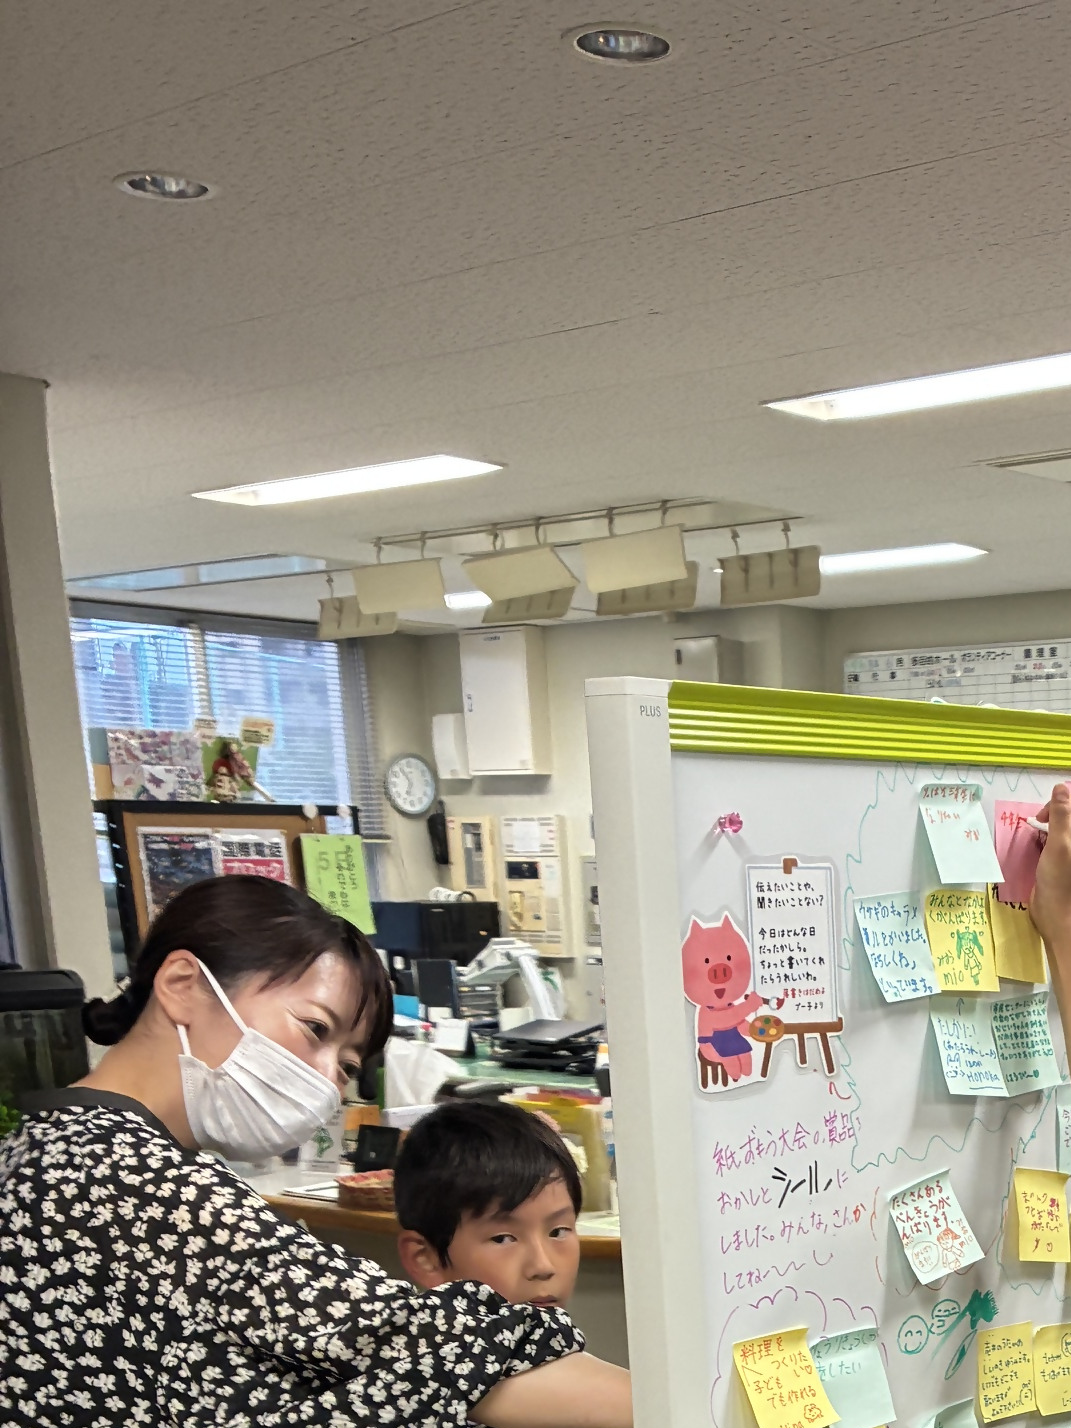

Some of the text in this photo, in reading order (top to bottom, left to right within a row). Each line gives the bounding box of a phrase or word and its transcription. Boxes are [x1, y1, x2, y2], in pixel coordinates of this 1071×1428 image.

[640, 705, 661, 717] PLUS
[756, 881, 815, 893] 伝えたいことや、
[759, 926, 816, 940] 今日はどんな日
[759, 942, 807, 955] だったかしら。
[760, 955, 825, 970] ちょっと書いてくれ
[761, 971, 817, 985] たらうれしいわ。
[892, 1179, 943, 1211] たくさんある
[740, 1335, 785, 1367] 料理を
[753, 1377, 784, 1395] 子ども
